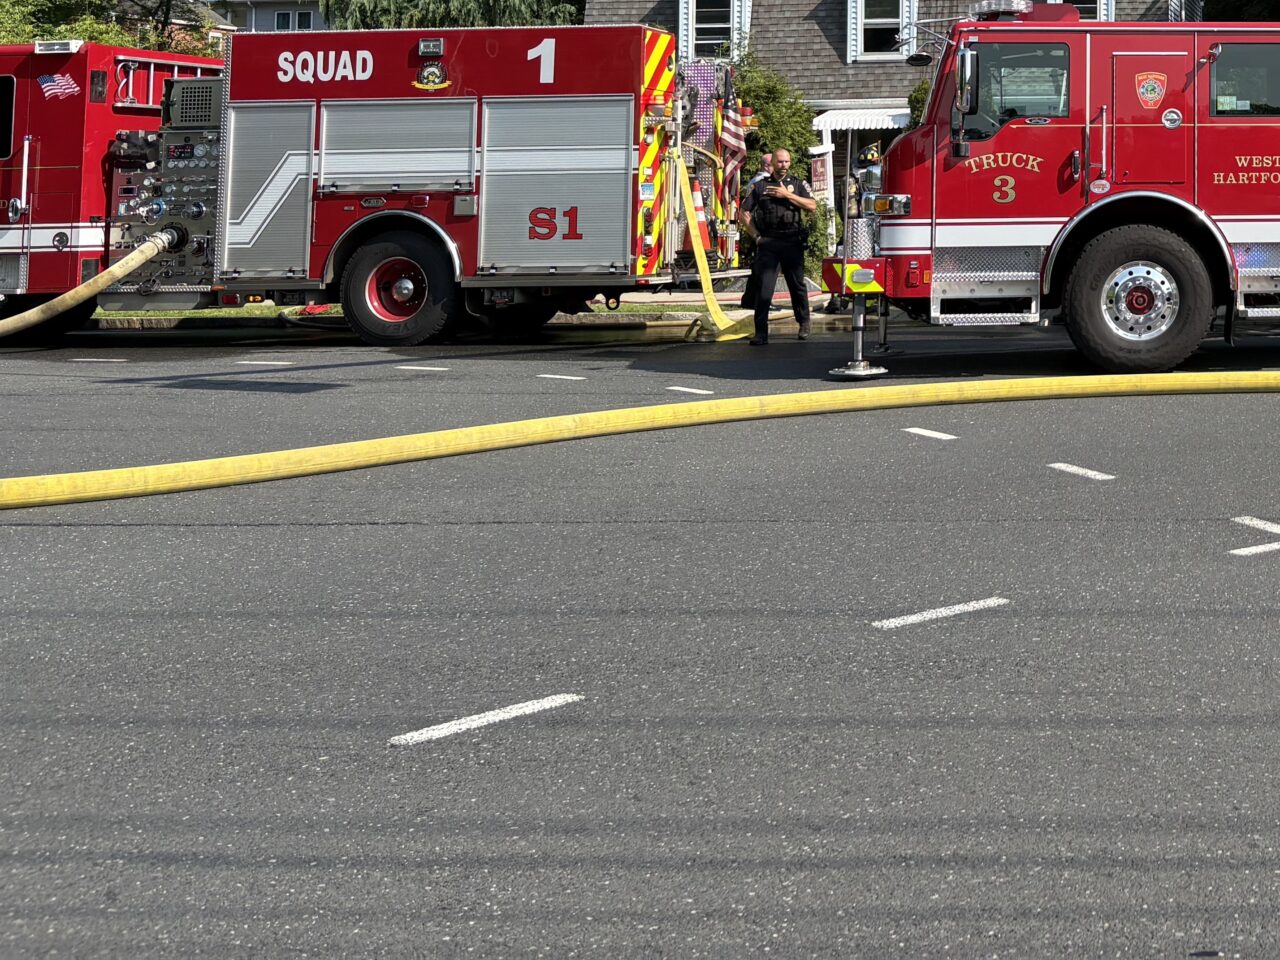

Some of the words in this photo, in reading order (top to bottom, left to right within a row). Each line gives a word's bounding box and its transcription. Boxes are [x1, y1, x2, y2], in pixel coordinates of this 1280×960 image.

[277, 50, 374, 84] SQUAD
[527, 38, 556, 84] 1
[965, 152, 1045, 174] TRUCK
[992, 175, 1016, 203] 3
[529, 205, 583, 240] S1
